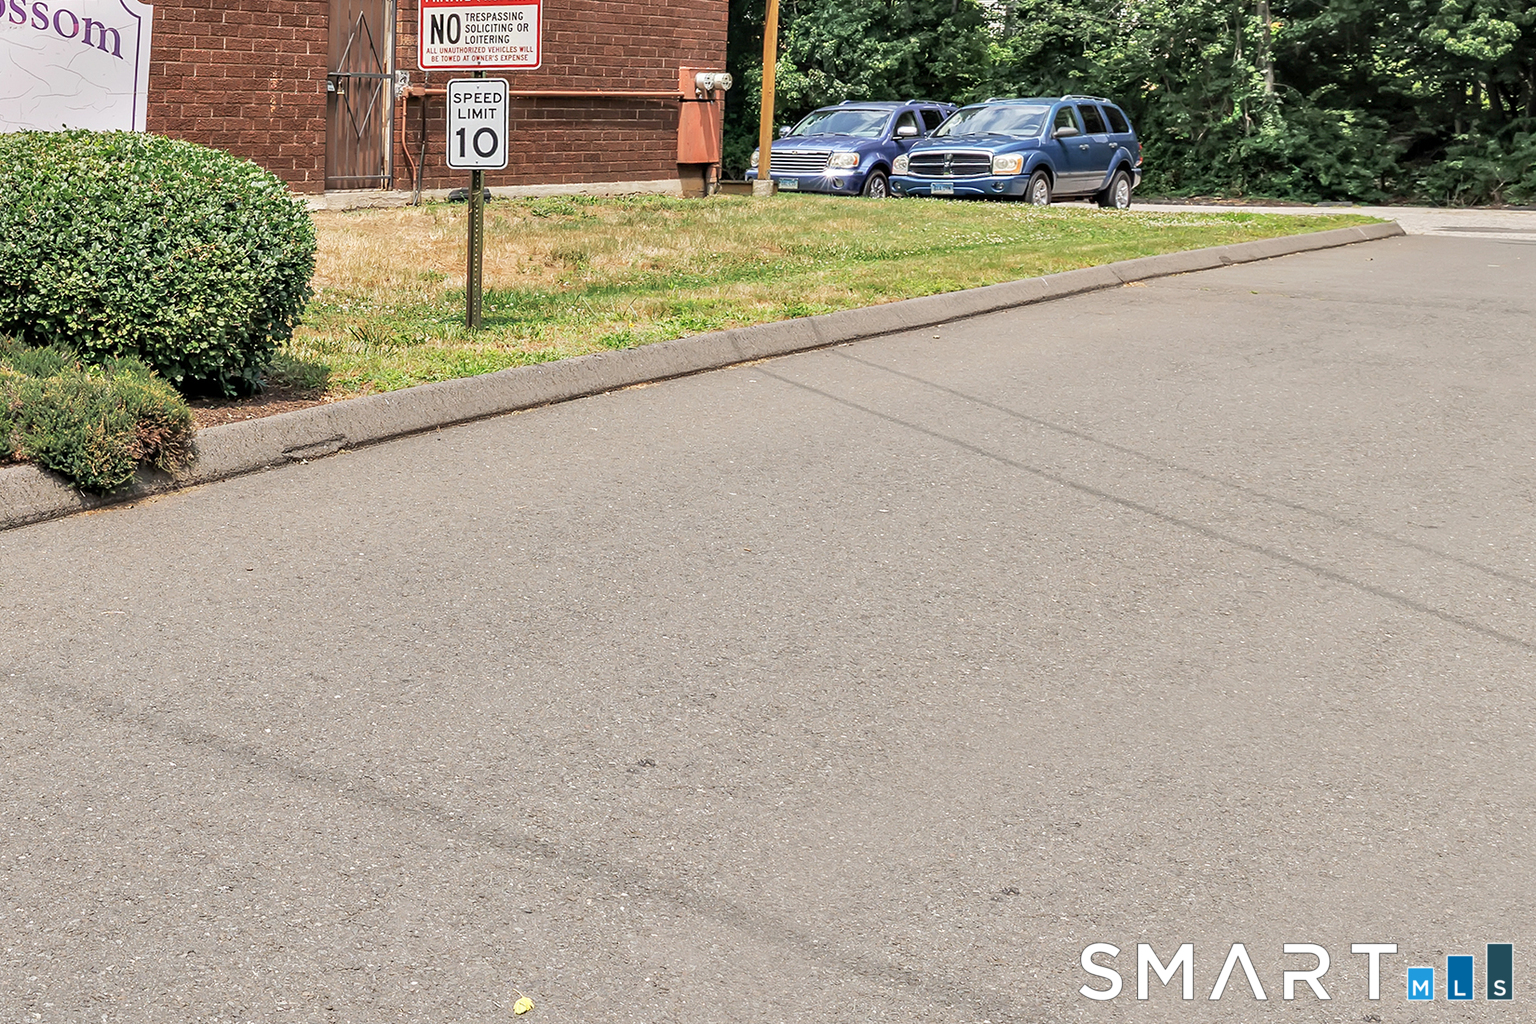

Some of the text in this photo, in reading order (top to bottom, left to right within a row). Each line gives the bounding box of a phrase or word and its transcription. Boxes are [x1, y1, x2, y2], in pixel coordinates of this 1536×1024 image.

[465, 11, 524, 22] TRESPASSING
[430, 13, 462, 45] NO
[465, 22, 529, 34] SOLICITING OR
[465, 34, 510, 45] LOITERING
[439, 46, 486, 54] UNAUTHORIZED
[488, 45, 518, 53] VEHICLES
[519, 45, 534, 53] WILL
[431, 55, 439, 63] BE
[462, 54, 470, 62] AT
[471, 54, 499, 62] OWNER'S
[453, 92, 502, 104] SPEED
[457, 108, 497, 119] LIMIT
[455, 127, 499, 158] 10
